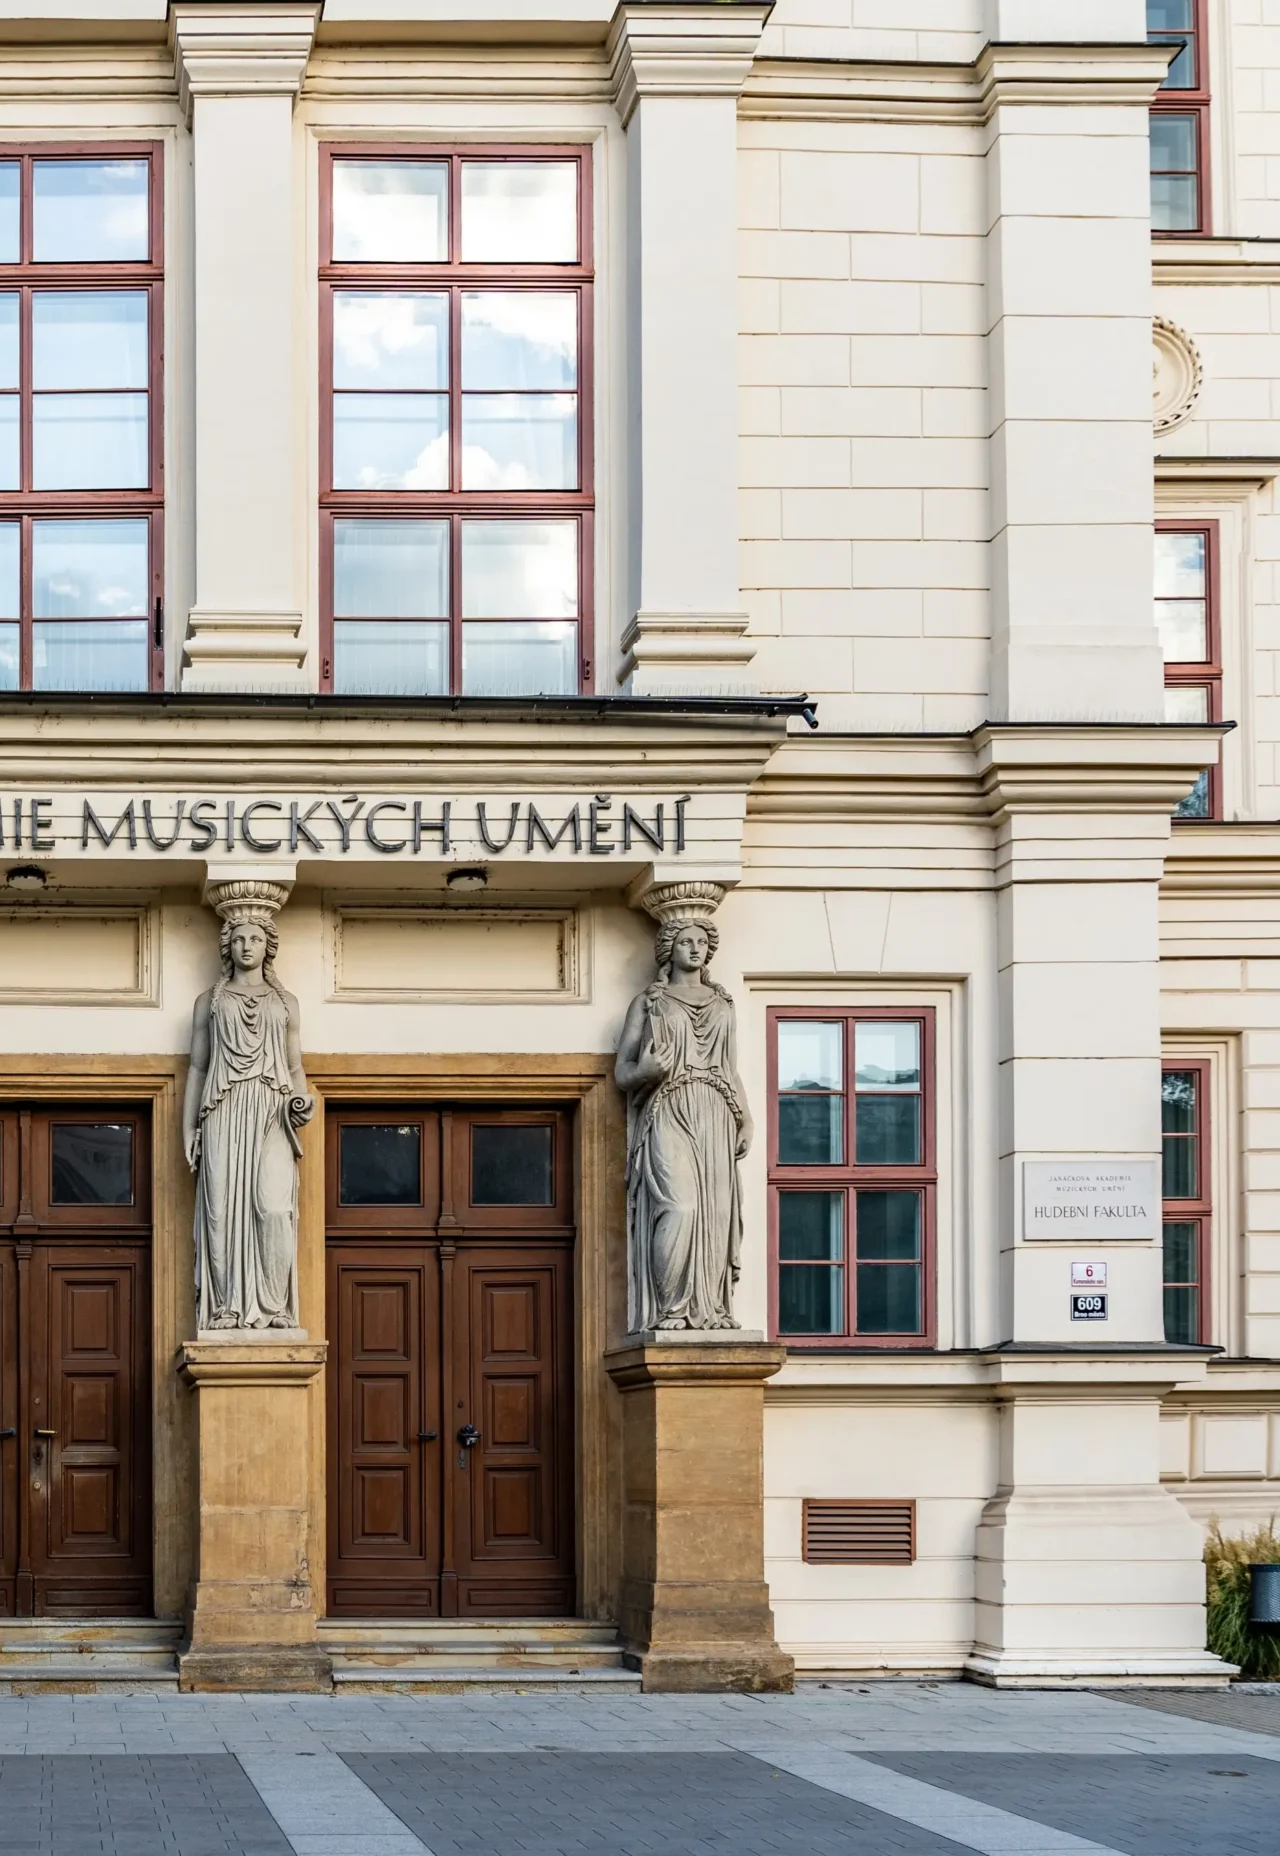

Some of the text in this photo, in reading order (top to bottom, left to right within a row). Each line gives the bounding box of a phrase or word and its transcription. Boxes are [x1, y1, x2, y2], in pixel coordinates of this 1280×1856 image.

[81, 794, 452, 854] MUSICKÝCH
[477, 793, 692, 855] UMĚNÍ
[1034, 1204, 1147, 1218] HUDEBNÍ FAKULTA
[1085, 1265, 1093, 1277] 6
[1077, 1297, 1102, 1310] 609
